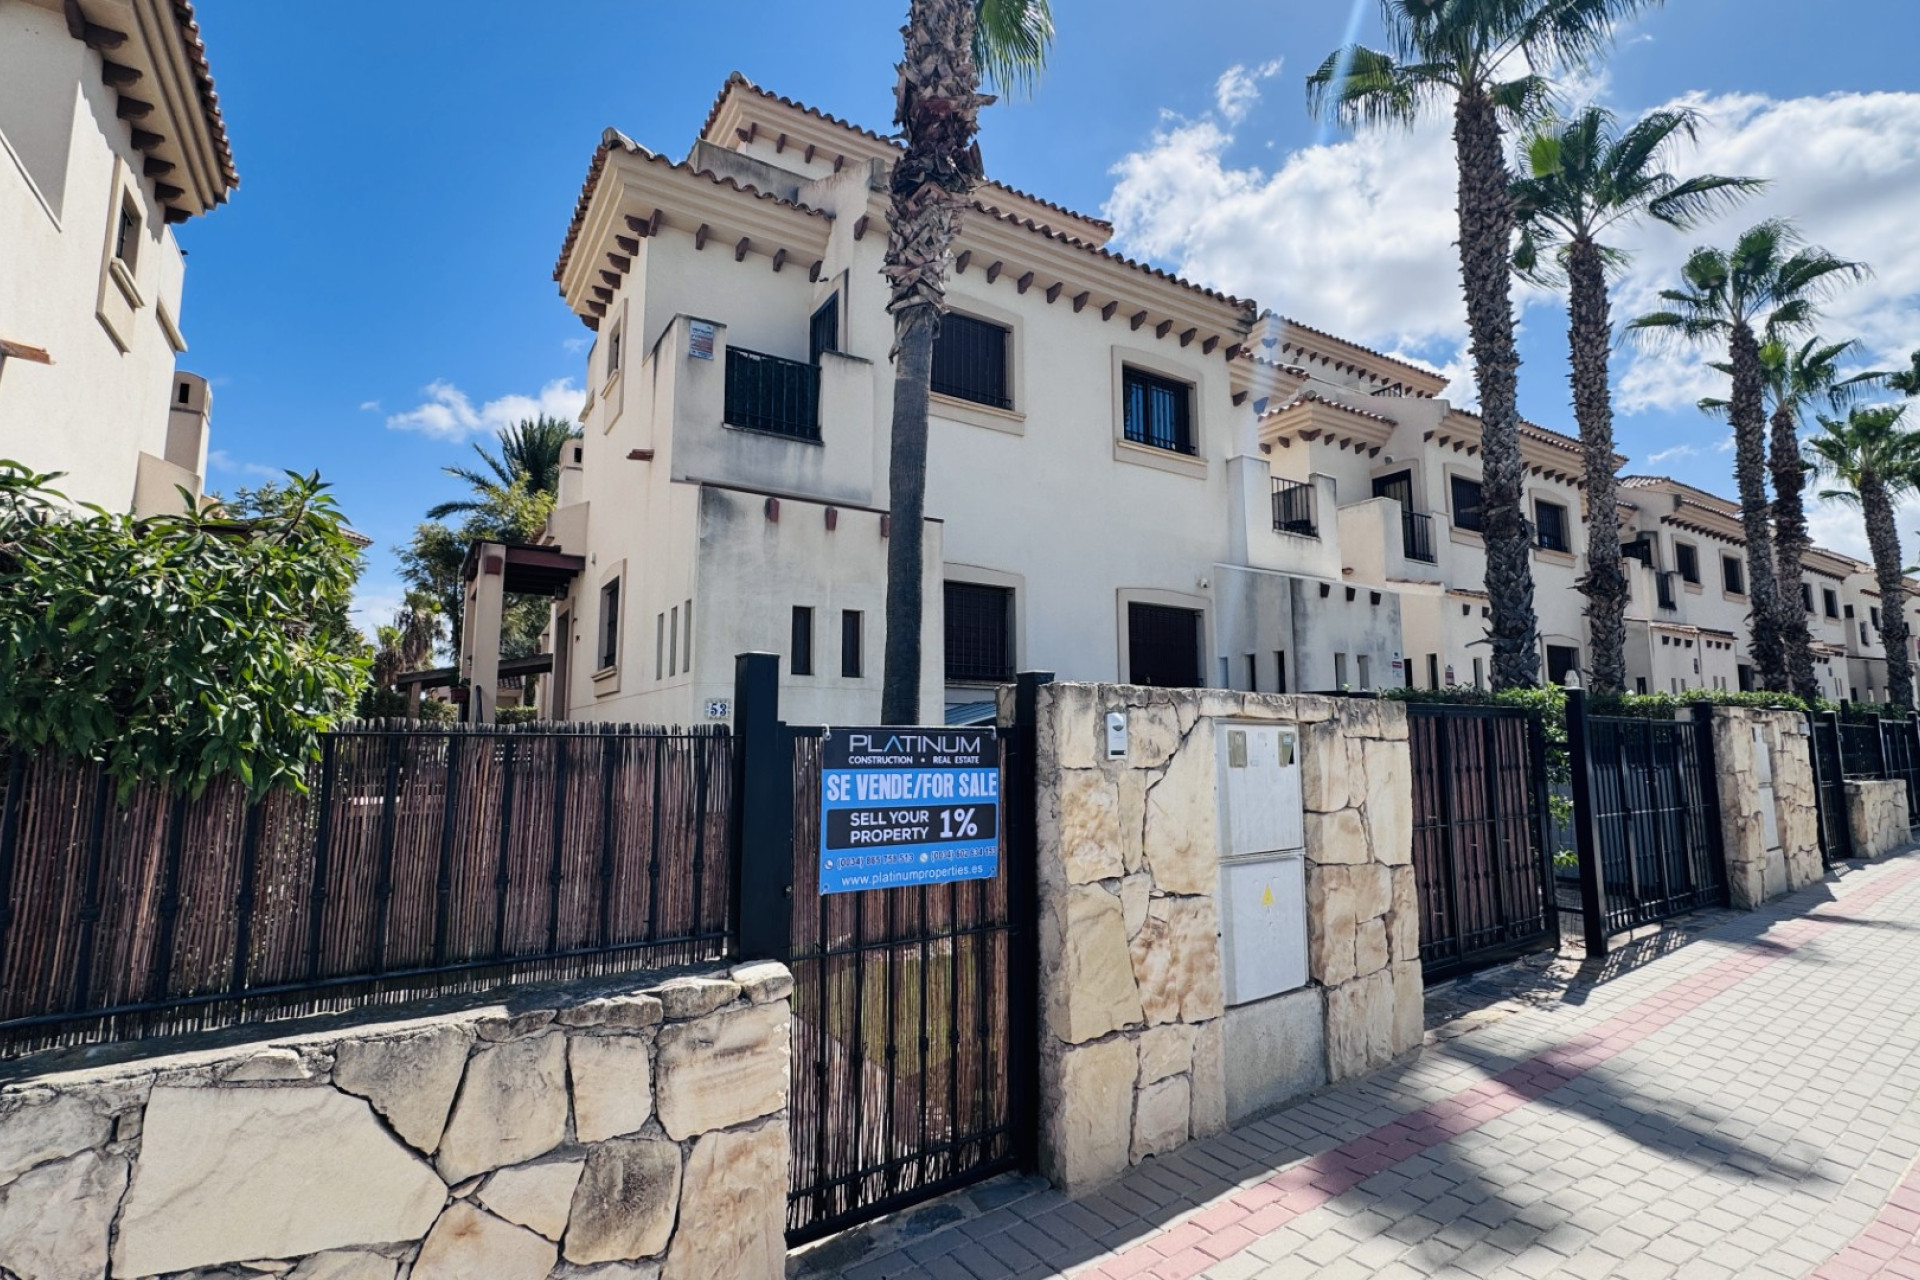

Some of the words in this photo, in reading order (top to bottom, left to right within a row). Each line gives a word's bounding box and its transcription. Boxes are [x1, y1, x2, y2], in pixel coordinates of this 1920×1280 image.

[710, 702, 727, 717] 53
[848, 734, 981, 753] PLATINUM
[848, 755, 913, 764] CONSTRUCTION
[932, 755, 952, 764] REAL
[954, 755, 980, 764] ESTATE
[826, 774, 851, 802] SE
[856, 772, 954, 801] VENDE/FOR
[958, 772, 997, 798] SALE
[850, 812, 886, 826] SELL
[889, 810, 930, 825] YOUR
[939, 807, 978, 839] 1%
[850, 828, 929, 844] PROPERTY
[841, 863, 984, 887] www.platinumproperties.es
